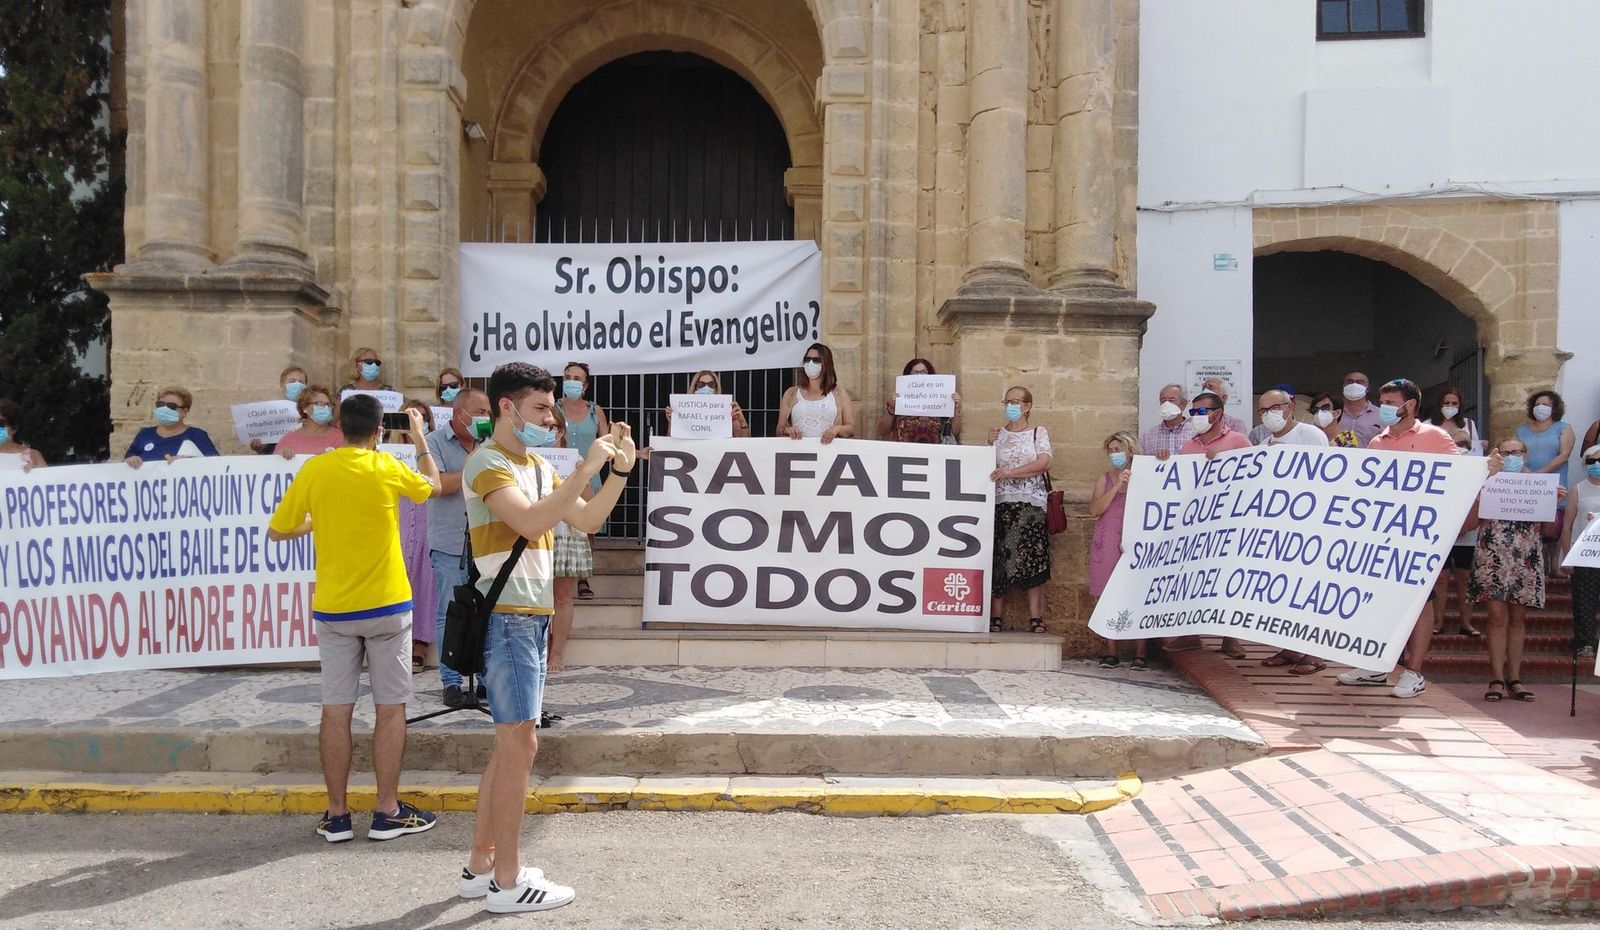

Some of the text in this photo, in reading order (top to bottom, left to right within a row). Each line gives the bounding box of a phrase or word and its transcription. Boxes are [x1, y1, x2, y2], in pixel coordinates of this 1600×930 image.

[554, 255, 739, 304] Sr. Obispo:
[469, 300, 820, 362] ¿Ha olvidado el Evangelio?
[678, 401, 708, 409] JUSTICIA
[907, 381, 925, 389] ¿Qué
[246, 419, 273, 429] rebaño
[274, 418, 286, 426] sin
[247, 409, 267, 418] ¿Qué
[268, 408, 278, 416] es
[678, 412, 703, 420] RAFAEL
[710, 413, 725, 421] para
[691, 424, 712, 432] CONIL
[248, 430, 268, 438] buen
[648, 450, 987, 502] RAFAEL
[1154, 450, 1452, 495] “A VECES UNO SABE
[1495, 478, 1524, 486] PORQUE
[1524, 478, 1531, 486] ÉL
[1513, 488, 1528, 496] NOS
[6, 481, 129, 529] PROFESORES
[134, 479, 167, 523] JOSE
[170, 465, 241, 522] JOAQUÍN
[245, 474, 256, 515] Y
[1142, 484, 1440, 545] DE QUÉ LADO ESTAR,
[646, 505, 982, 558] SOMOS
[1129, 527, 1237, 570] SIMPLEMENTE
[1237, 527, 1322, 565] VIENDO
[16, 538, 55, 588] LOS
[62, 533, 145, 584] AMIGOS
[148, 531, 176, 579] DEL
[180, 527, 229, 577] BAILE
[235, 526, 259, 574] DE
[646, 563, 917, 614] TODOS
[1144, 565, 1190, 606] ESTÁN
[1190, 568, 1221, 600] DEL
[1225, 568, 1288, 604] OTRO
[138, 590, 161, 655] AL
[165, 585, 235, 654] PADRE
[927, 600, 981, 613] Cáritas
[1139, 611, 1187, 630] CONSEJO
[1186, 608, 1226, 625] LOCAL
[1229, 611, 1252, 629] DE
